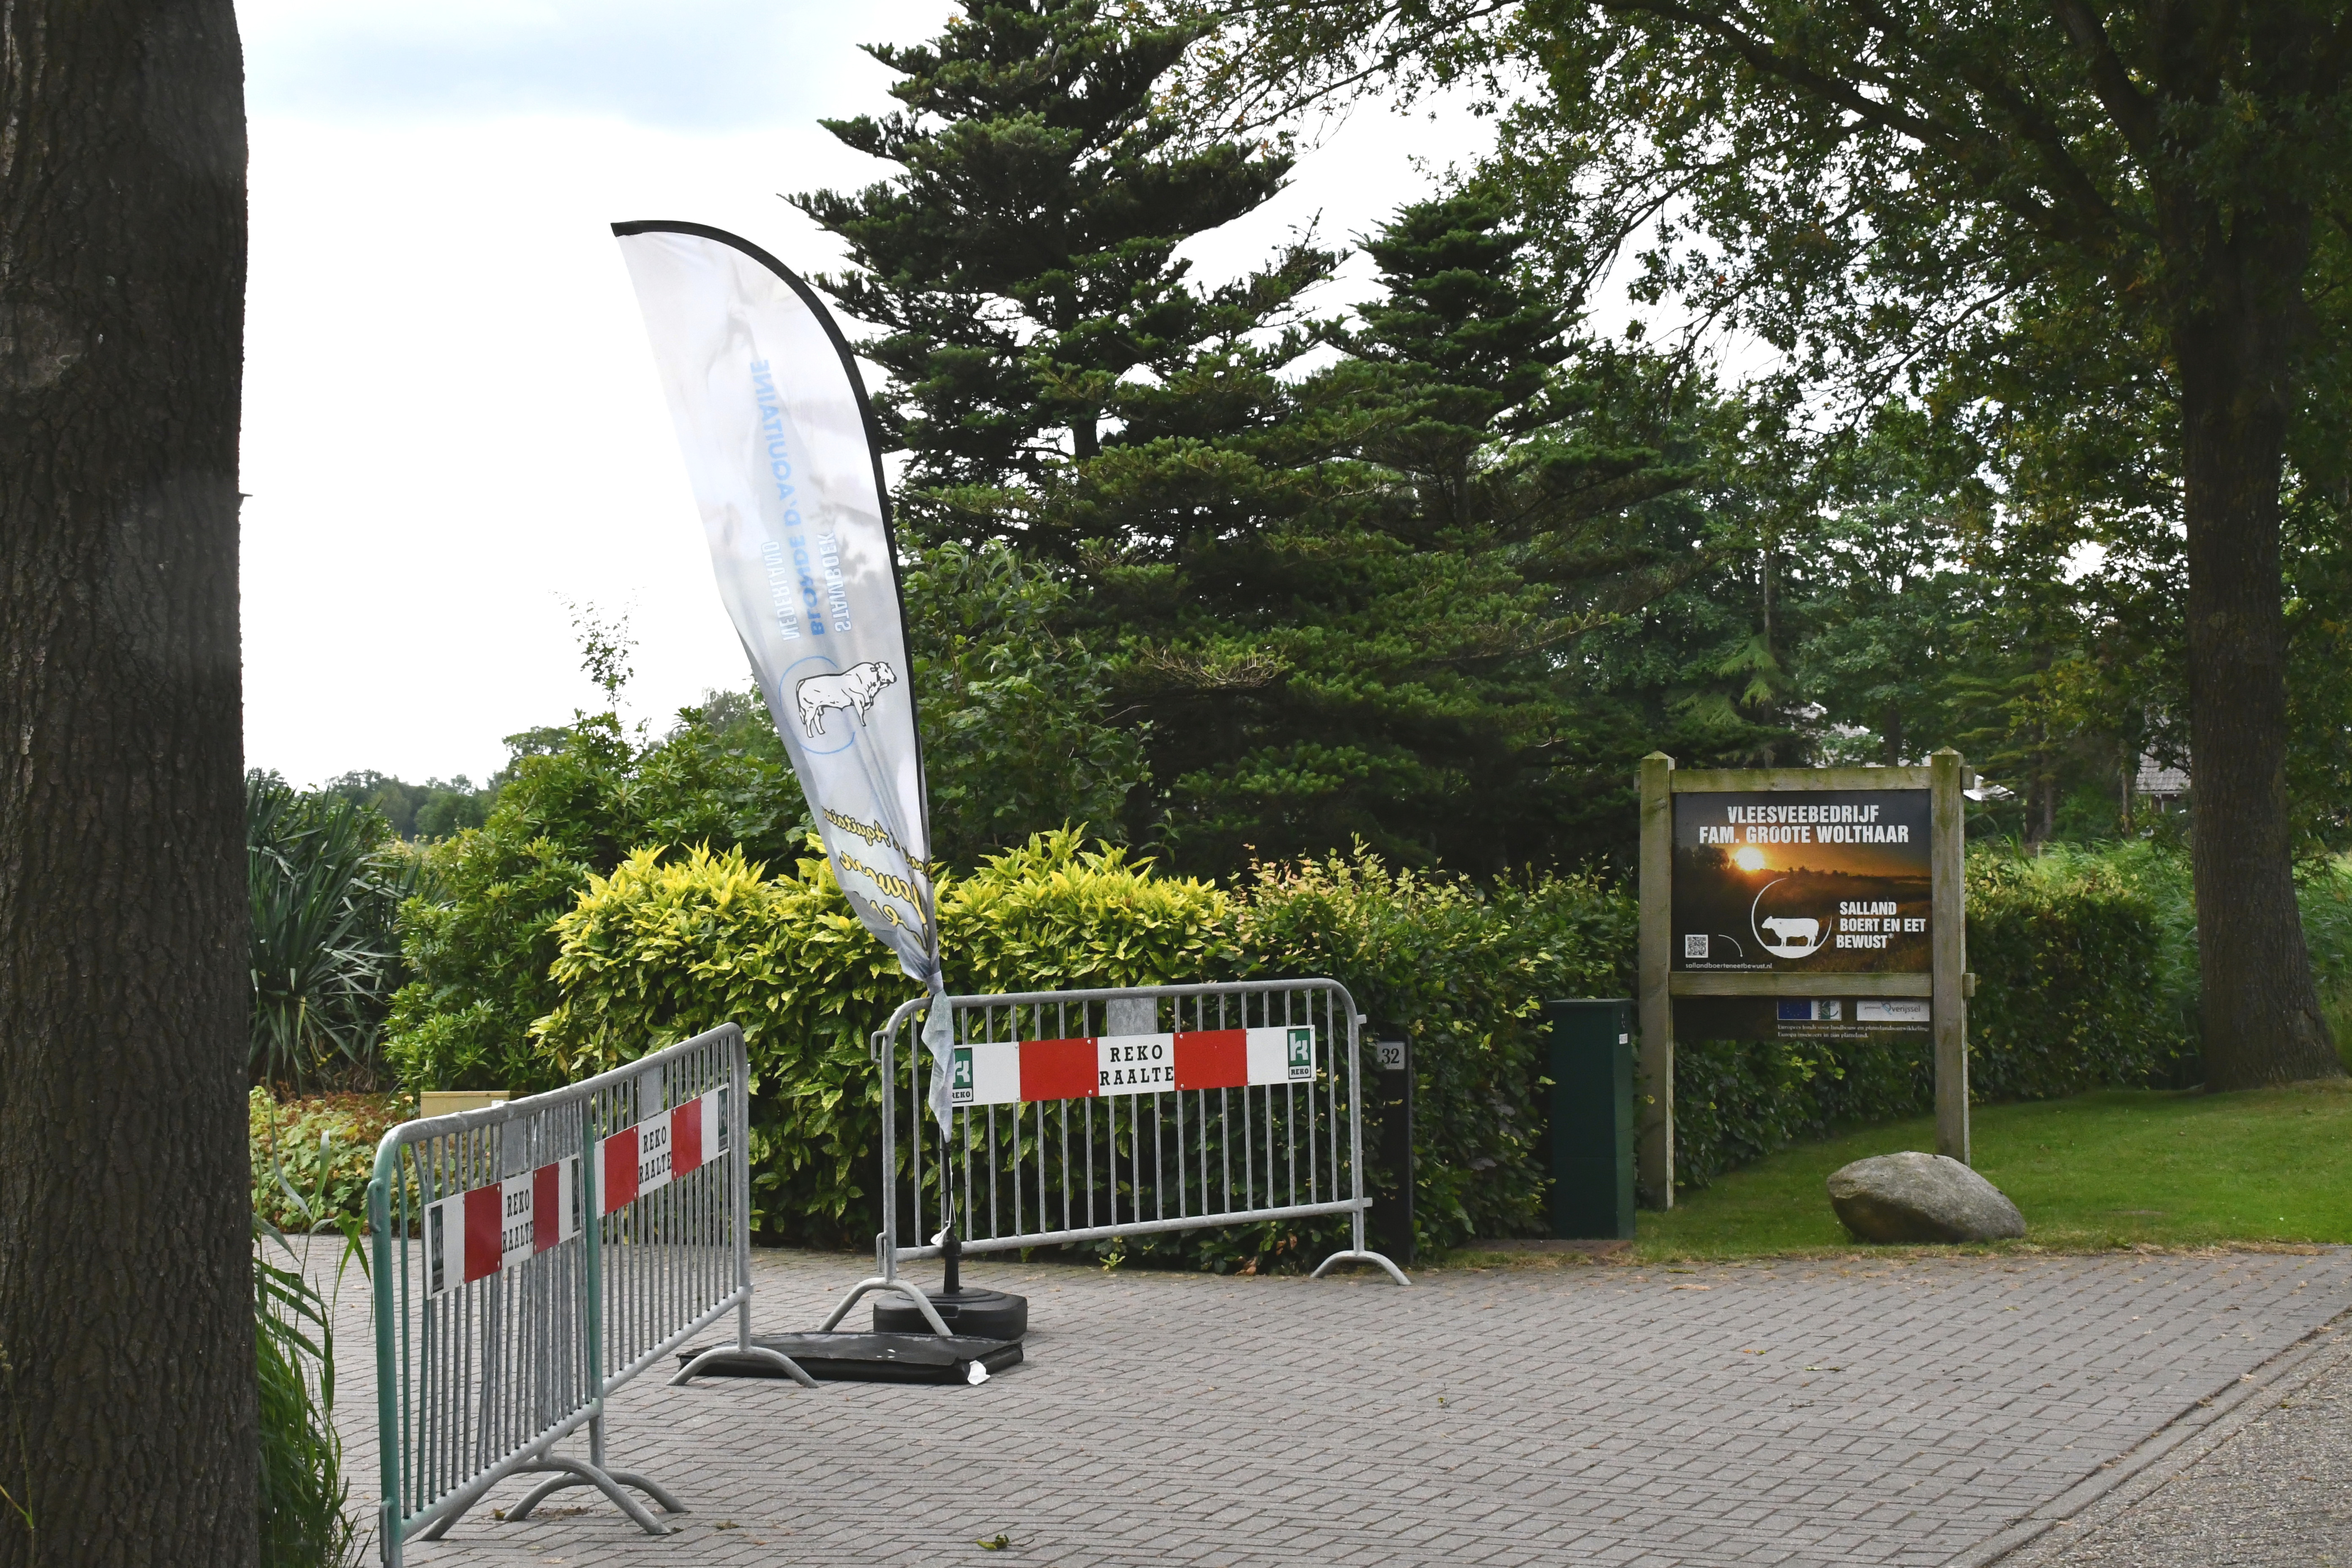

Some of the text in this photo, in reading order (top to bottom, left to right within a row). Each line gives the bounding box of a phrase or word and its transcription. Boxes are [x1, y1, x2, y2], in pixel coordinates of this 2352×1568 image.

[1727, 805, 1879, 823] VLEESVEEBEDRIJF
[1699, 825, 1909, 844] FAM. GROOTE WOLTHAAR
[1840, 901, 1897, 915] SALLAND
[1840, 918, 1926, 932] BOERT EN EET
[1110, 1045, 1162, 1062] REKO
[1381, 1048, 1399, 1064] 32
[1100, 1066, 1173, 1086] RAALTE
[643, 1126, 666, 1154] REKO
[639, 1151, 671, 1184] RAALTE
[507, 1189, 529, 1217] REKO
[502, 1220, 534, 1253] RAALTE
